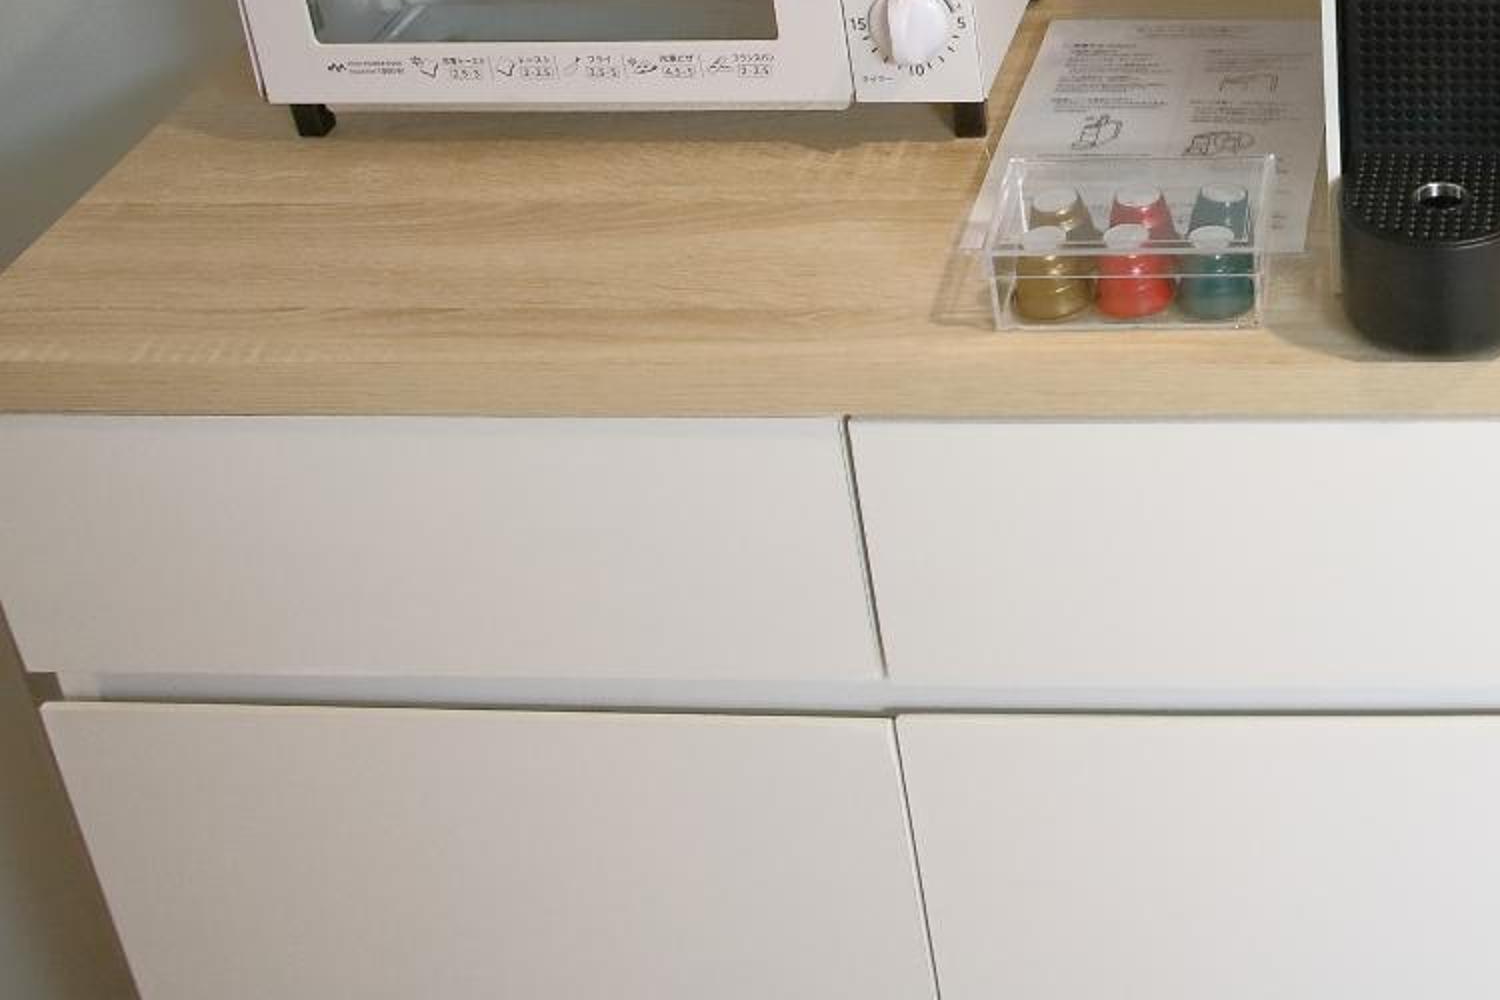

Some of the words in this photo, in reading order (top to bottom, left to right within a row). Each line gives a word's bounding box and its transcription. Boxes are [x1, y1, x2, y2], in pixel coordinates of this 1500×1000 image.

[850, 17, 867, 31] 15
[956, 16, 967, 29] 5
[909, 64, 926, 77] 10
